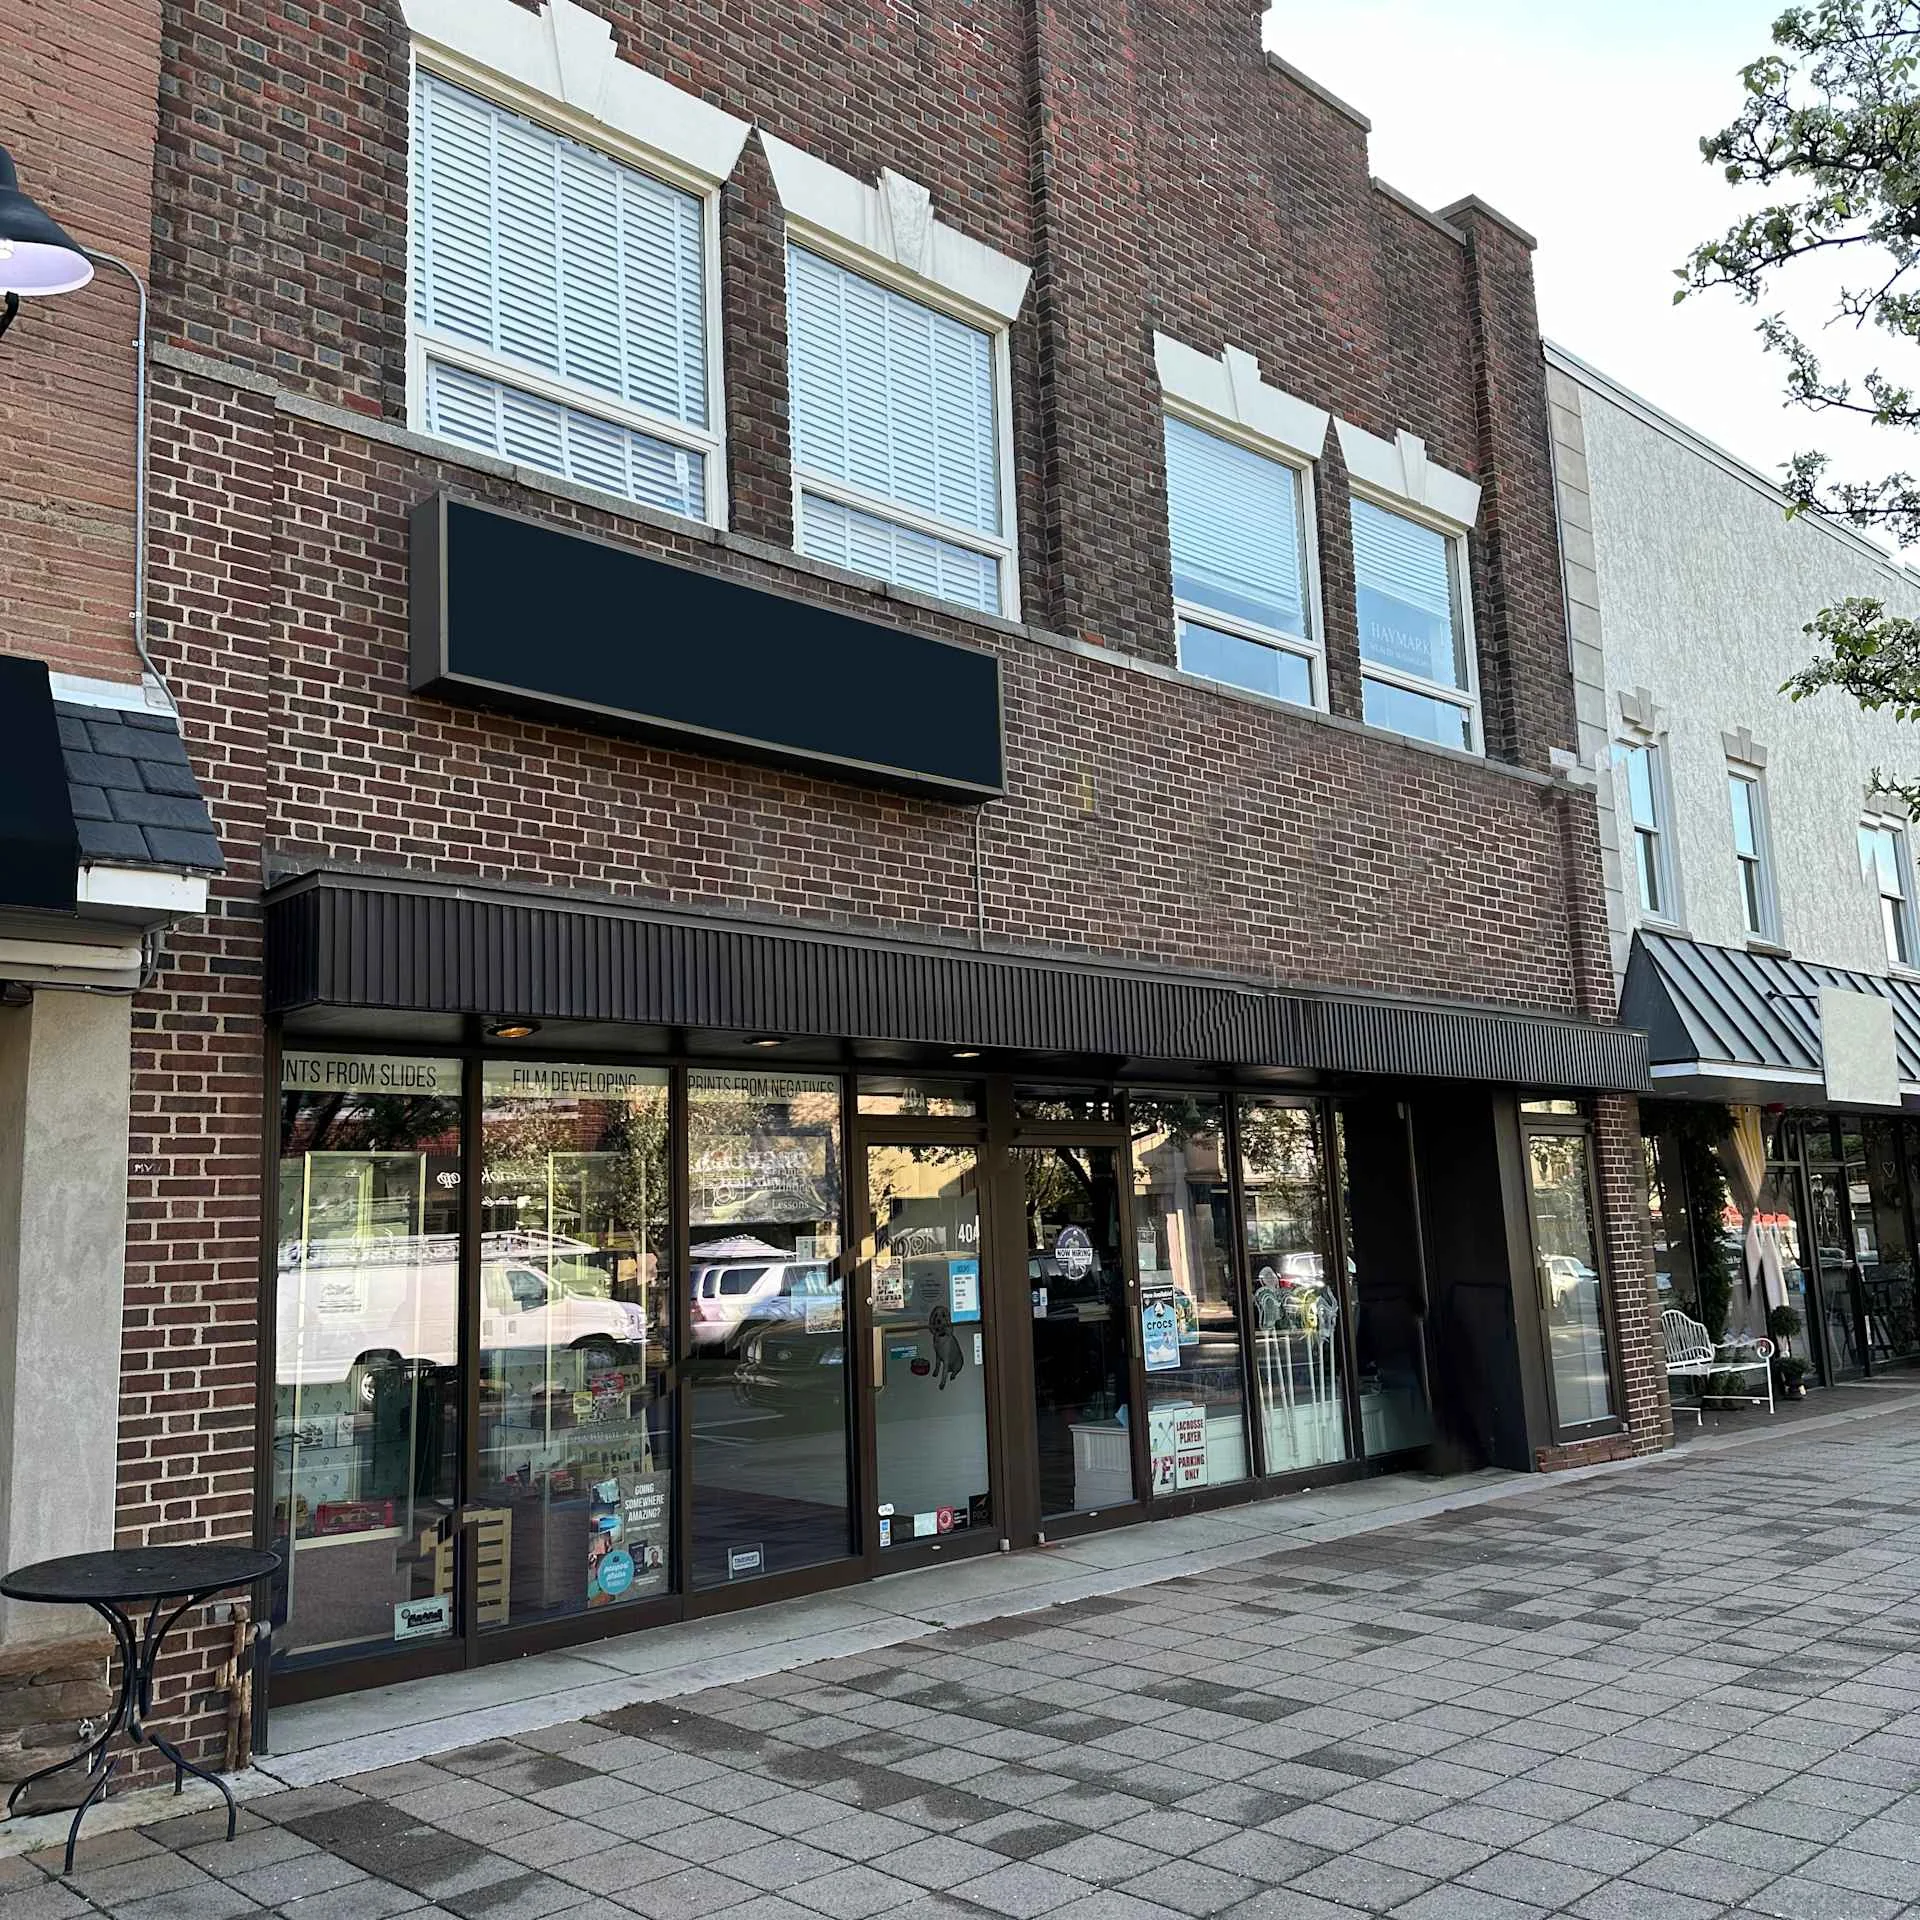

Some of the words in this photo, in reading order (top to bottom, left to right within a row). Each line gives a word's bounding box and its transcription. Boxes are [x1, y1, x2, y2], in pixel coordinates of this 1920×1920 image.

[326, 1061, 375, 1086] FROM
[380, 1063, 437, 1088] SLIDES
[513, 1069, 548, 1091] FILM
[551, 1071, 637, 1094] DEVELOPING
[688, 1075, 731, 1091] PRINTS
[734, 1077, 768, 1097] FROM
[771, 1079, 835, 1098] NEGATIVES
[772, 1199, 809, 1209] Lessons
[1057, 1248, 1071, 1257] NOW
[1071, 1248, 1091, 1257] HIRING
[1147, 1319, 1173, 1330] crocs
[1176, 1419, 1203, 1431] LACROSSE
[1180, 1431, 1201, 1444] PLAYER
[1178, 1454, 1205, 1468] PARKING
[1184, 1468, 1199, 1480] ONLY
[635, 1483, 655, 1495] GOING
[625, 1494, 665, 1510] SOMEWHERE
[628, 1507, 661, 1522] AMAZING?
